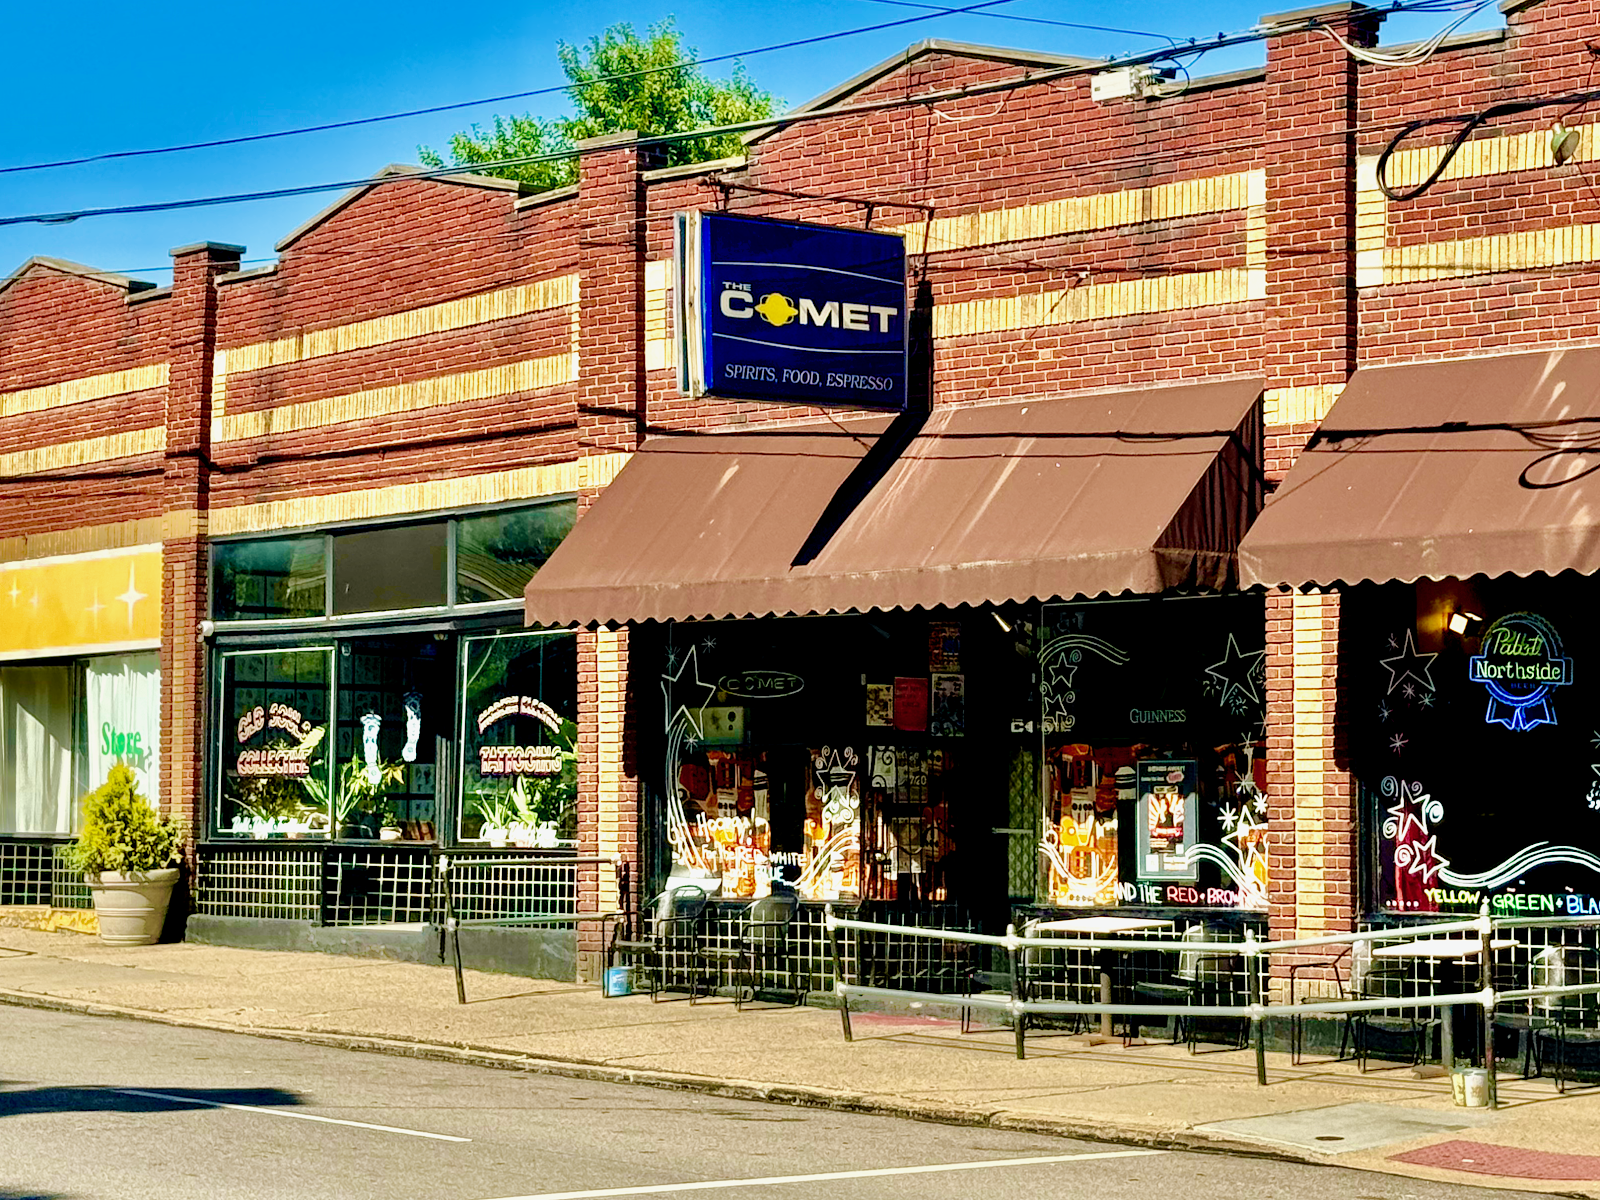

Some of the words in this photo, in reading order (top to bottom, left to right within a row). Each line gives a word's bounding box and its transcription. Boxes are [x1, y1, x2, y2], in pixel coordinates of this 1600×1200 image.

[722, 281, 751, 291] THE
[720, 289, 898, 333] COMET
[724, 363, 778, 383] SPIRITS,
[782, 368, 822, 387] FOOD,
[826, 373, 893, 391] ESPRESSO
[1492, 627, 1543, 656] Pabst
[727, 676, 797, 690] COMET
[1475, 660, 1561, 680] Northside
[238, 706, 265, 743] OLD
[268, 703, 311, 742] SOULS
[1130, 709, 1186, 723] GUINNESS
[101, 721, 143, 755] Store
[237, 750, 310, 777] COLLECTIVE
[480, 746, 562, 775] TATTOOING
[769, 850, 807, 867] WHITE
[1139, 882, 1163, 904] THE
[1167, 885, 1198, 904] RED
[1424, 887, 1480, 904] YELLOW
[1492, 893, 1555, 913] GREEN
